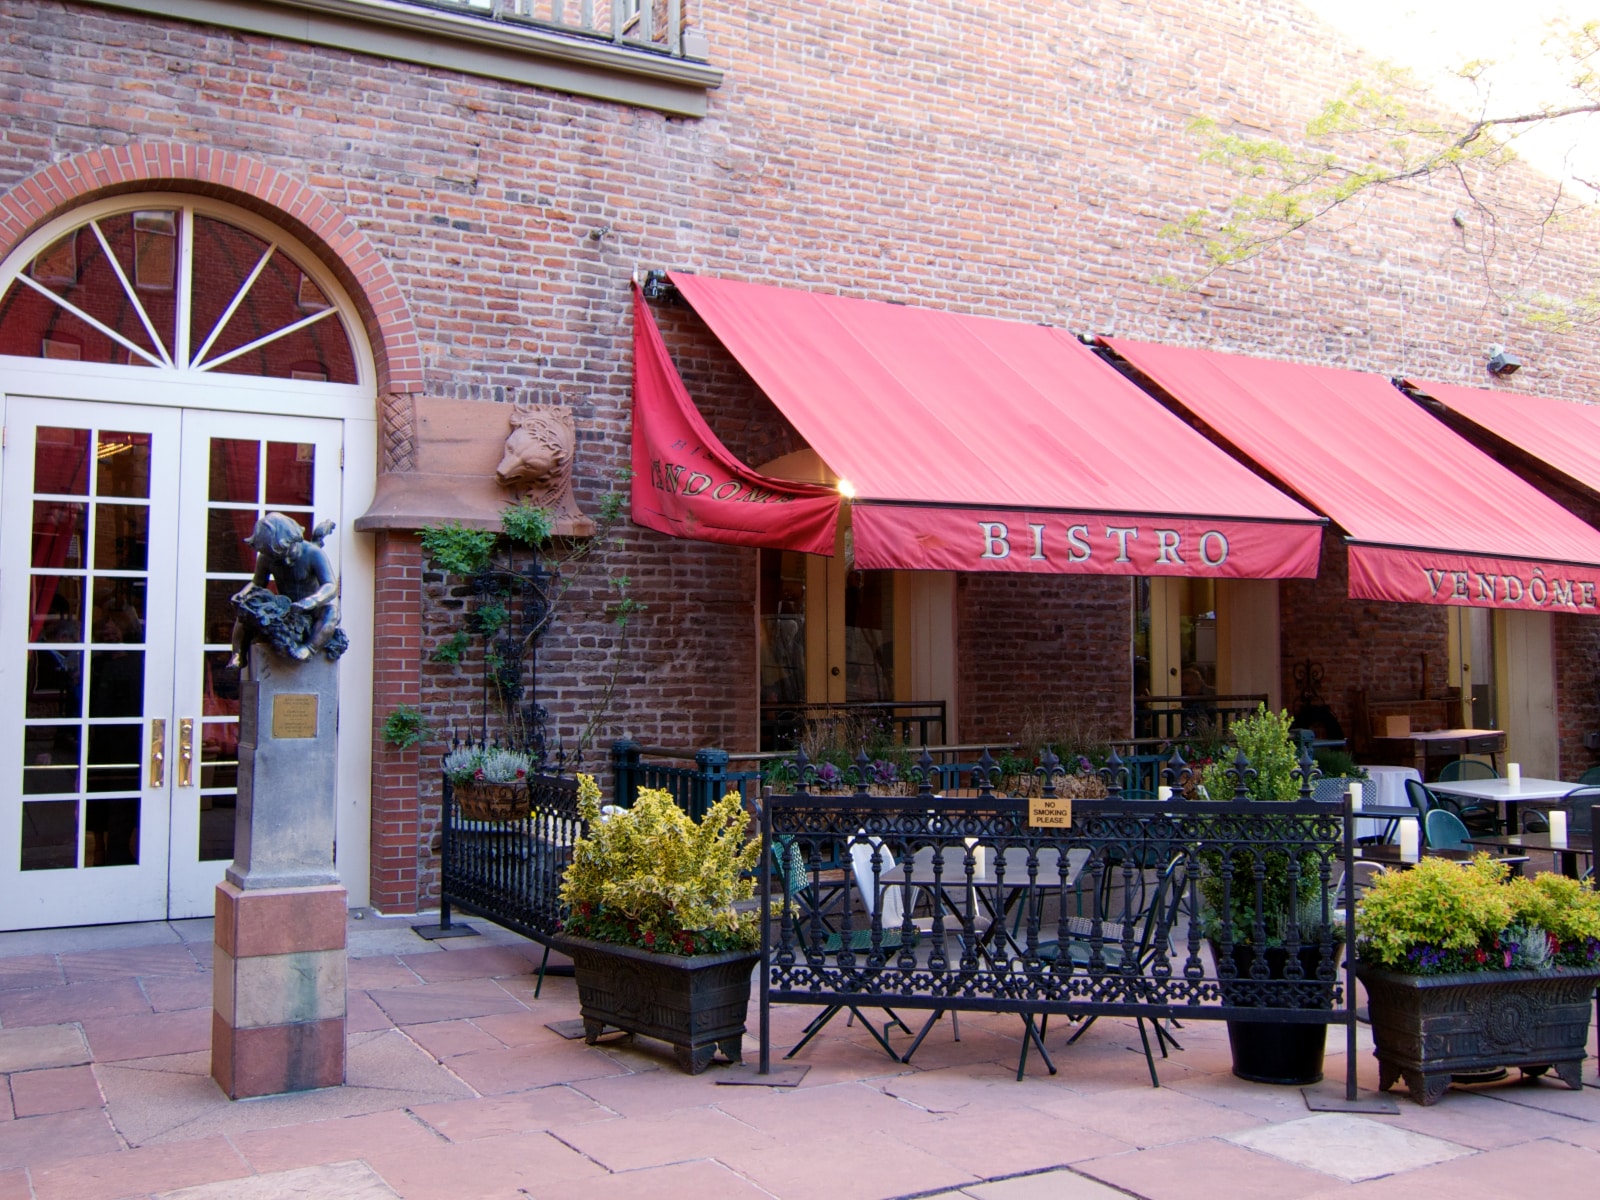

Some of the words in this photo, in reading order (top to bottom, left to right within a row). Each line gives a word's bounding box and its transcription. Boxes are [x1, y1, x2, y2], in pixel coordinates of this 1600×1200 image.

[978, 521, 1230, 567] BISTRO
[1423, 566, 1597, 609] VENDÔME
[1044, 801, 1056, 809] NO
[1033, 809, 1068, 817] SMOKING
[1036, 816, 1064, 824] PLEASE
